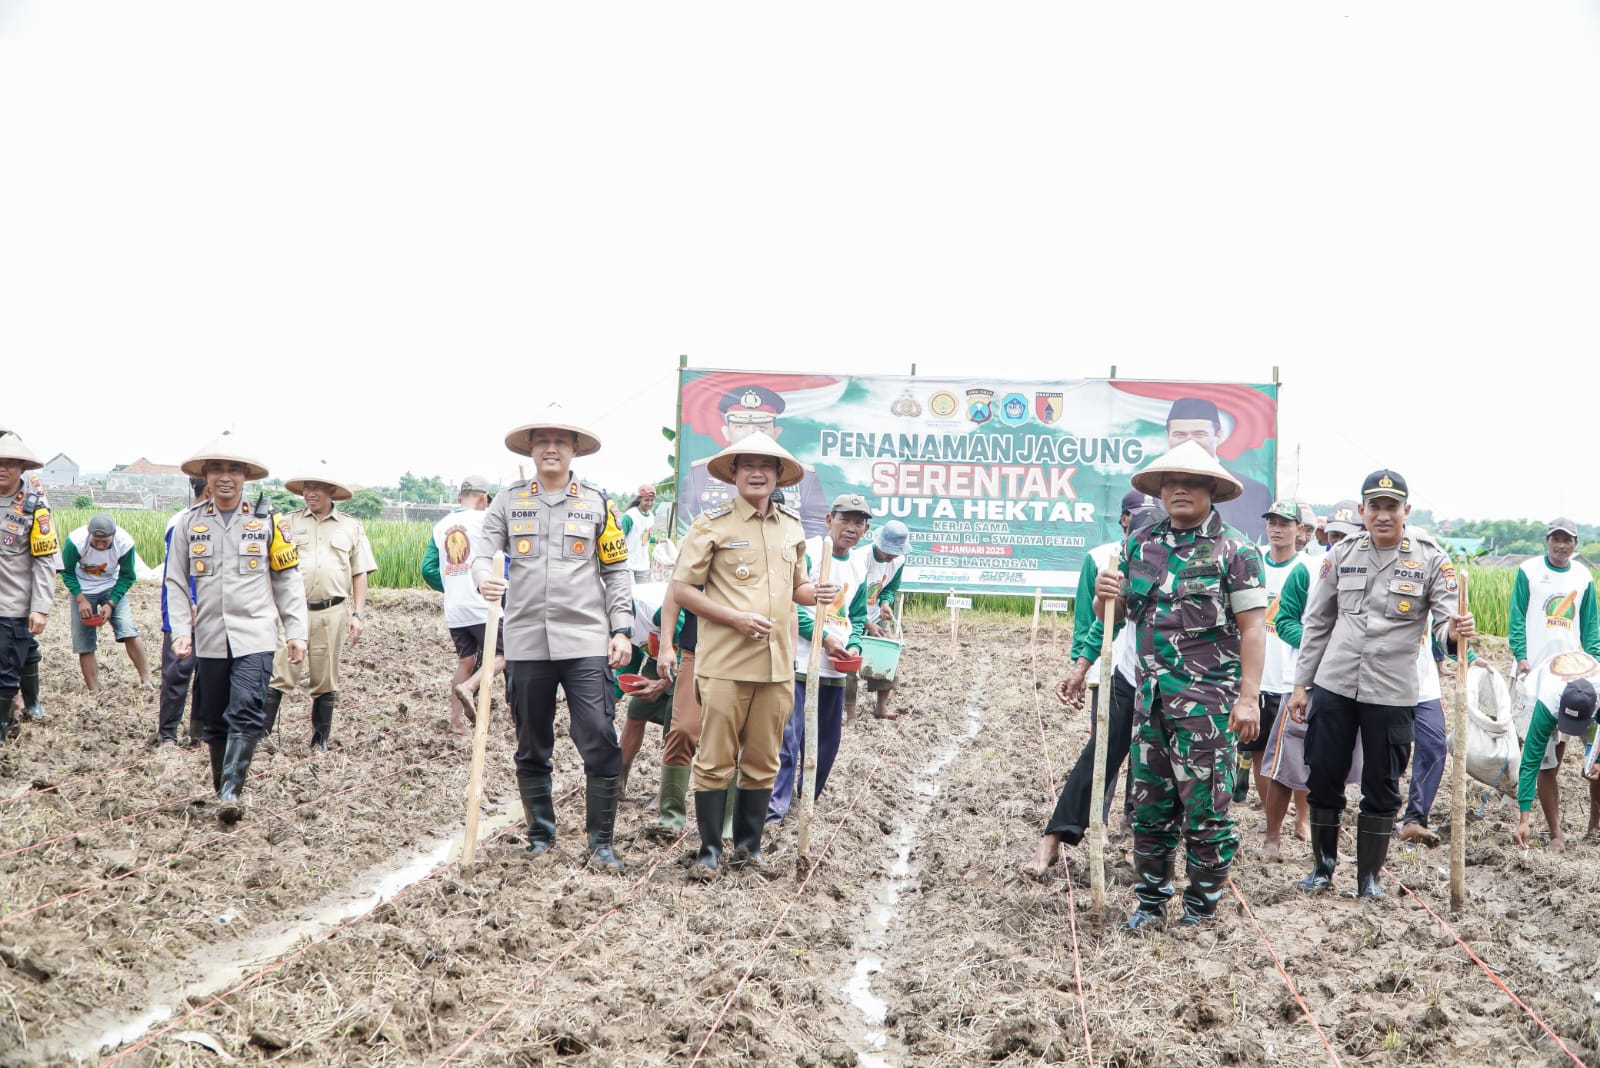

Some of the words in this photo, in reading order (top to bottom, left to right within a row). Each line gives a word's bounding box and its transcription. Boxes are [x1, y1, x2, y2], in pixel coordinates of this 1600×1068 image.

[821, 430, 1011, 462] PENANAMAN
[1017, 435, 1144, 465] JAGUNG
[872, 462, 1077, 499] SERENTAK
[567, 512, 593, 520] POLRI
[872, 497, 957, 519] JUTA
[963, 499, 1095, 522] HEKTAR
[934, 521, 972, 531] KERJA
[975, 522, 1009, 532] SAMA
[908, 532, 960, 542] EMENTAN
[991, 535, 1043, 545] SWADAYA
[1045, 536, 1085, 546] PETANI
[602, 541, 616, 553] KA
[939, 545, 948, 553] 21
[949, 545, 985, 554] JANUARI
[985, 547, 1006, 555] 2025
[907, 555, 959, 567] POLRES
[962, 557, 1038, 569] LAMONGAN
[1393, 569, 1424, 579] POLRI
